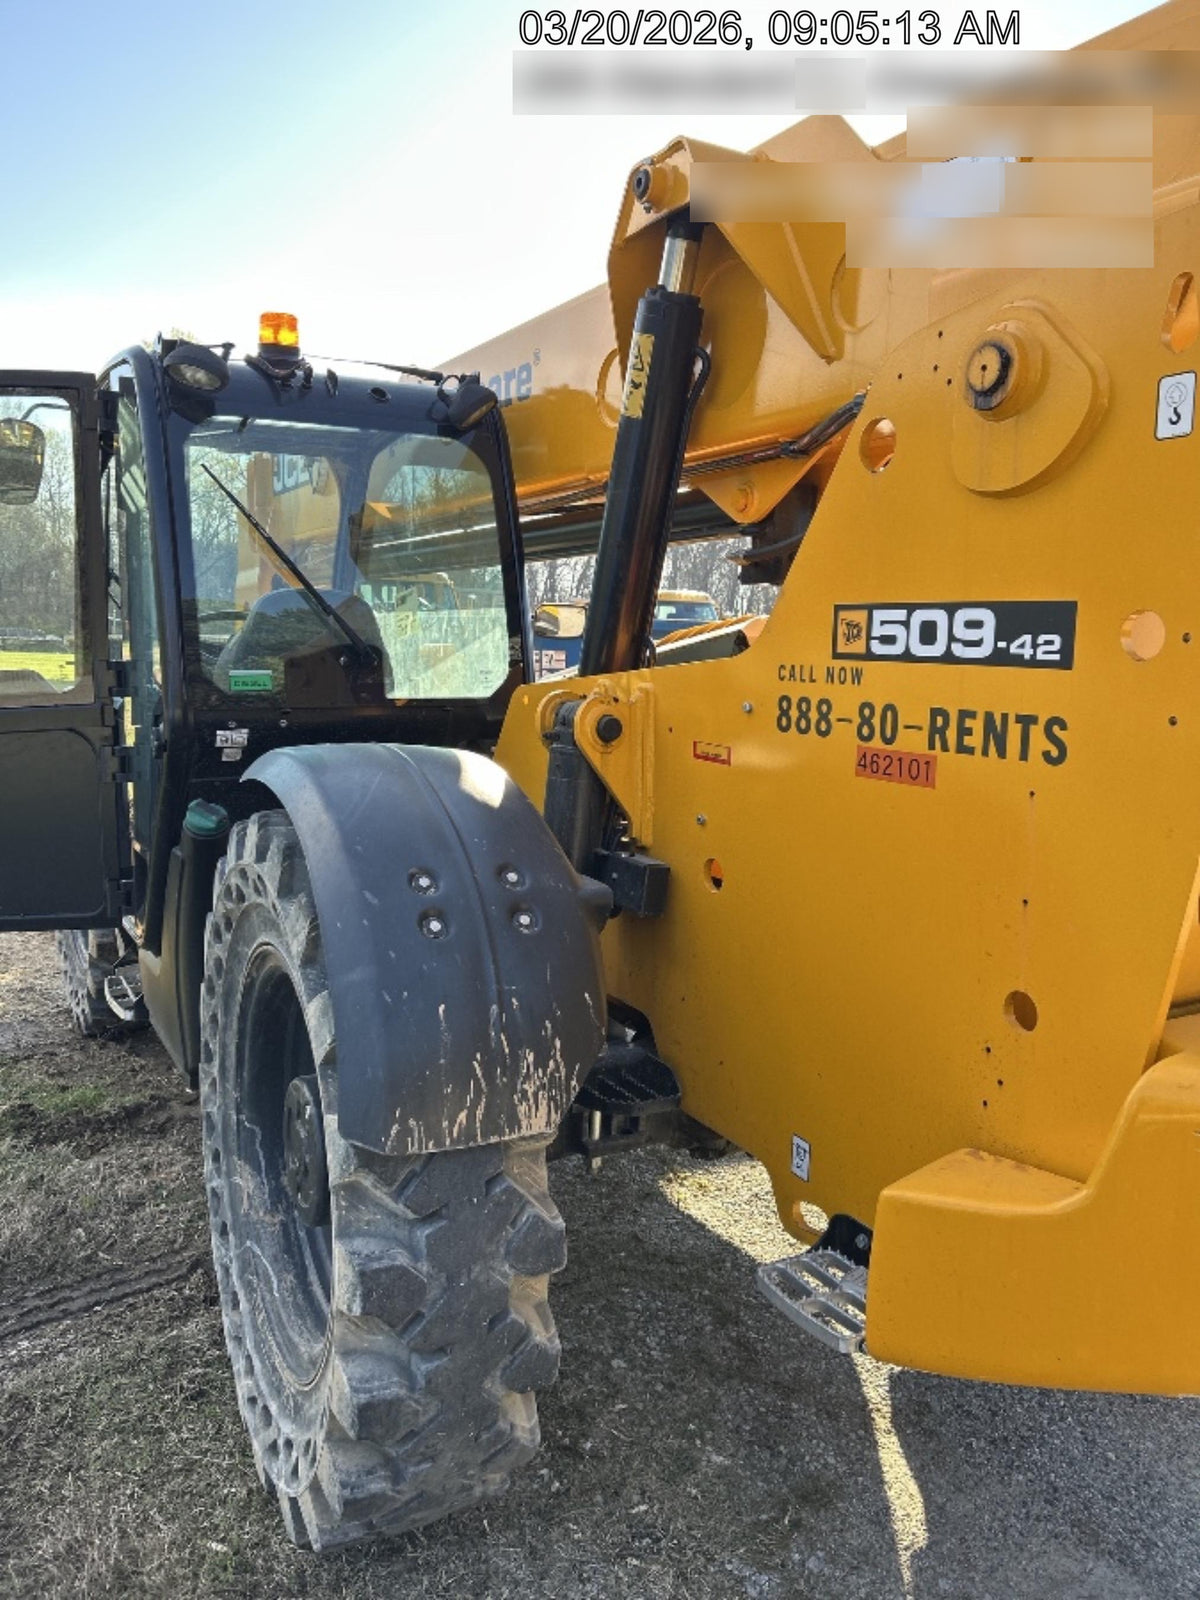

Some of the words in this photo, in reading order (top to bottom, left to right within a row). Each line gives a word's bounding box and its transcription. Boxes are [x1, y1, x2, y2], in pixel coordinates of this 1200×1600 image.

[869, 607, 1062, 661] 509-42
[778, 664, 816, 683] CALL
[826, 666, 863, 686] NOW
[776, 694, 1068, 766] 888-80-RENTS
[857, 751, 931, 783] 462101
